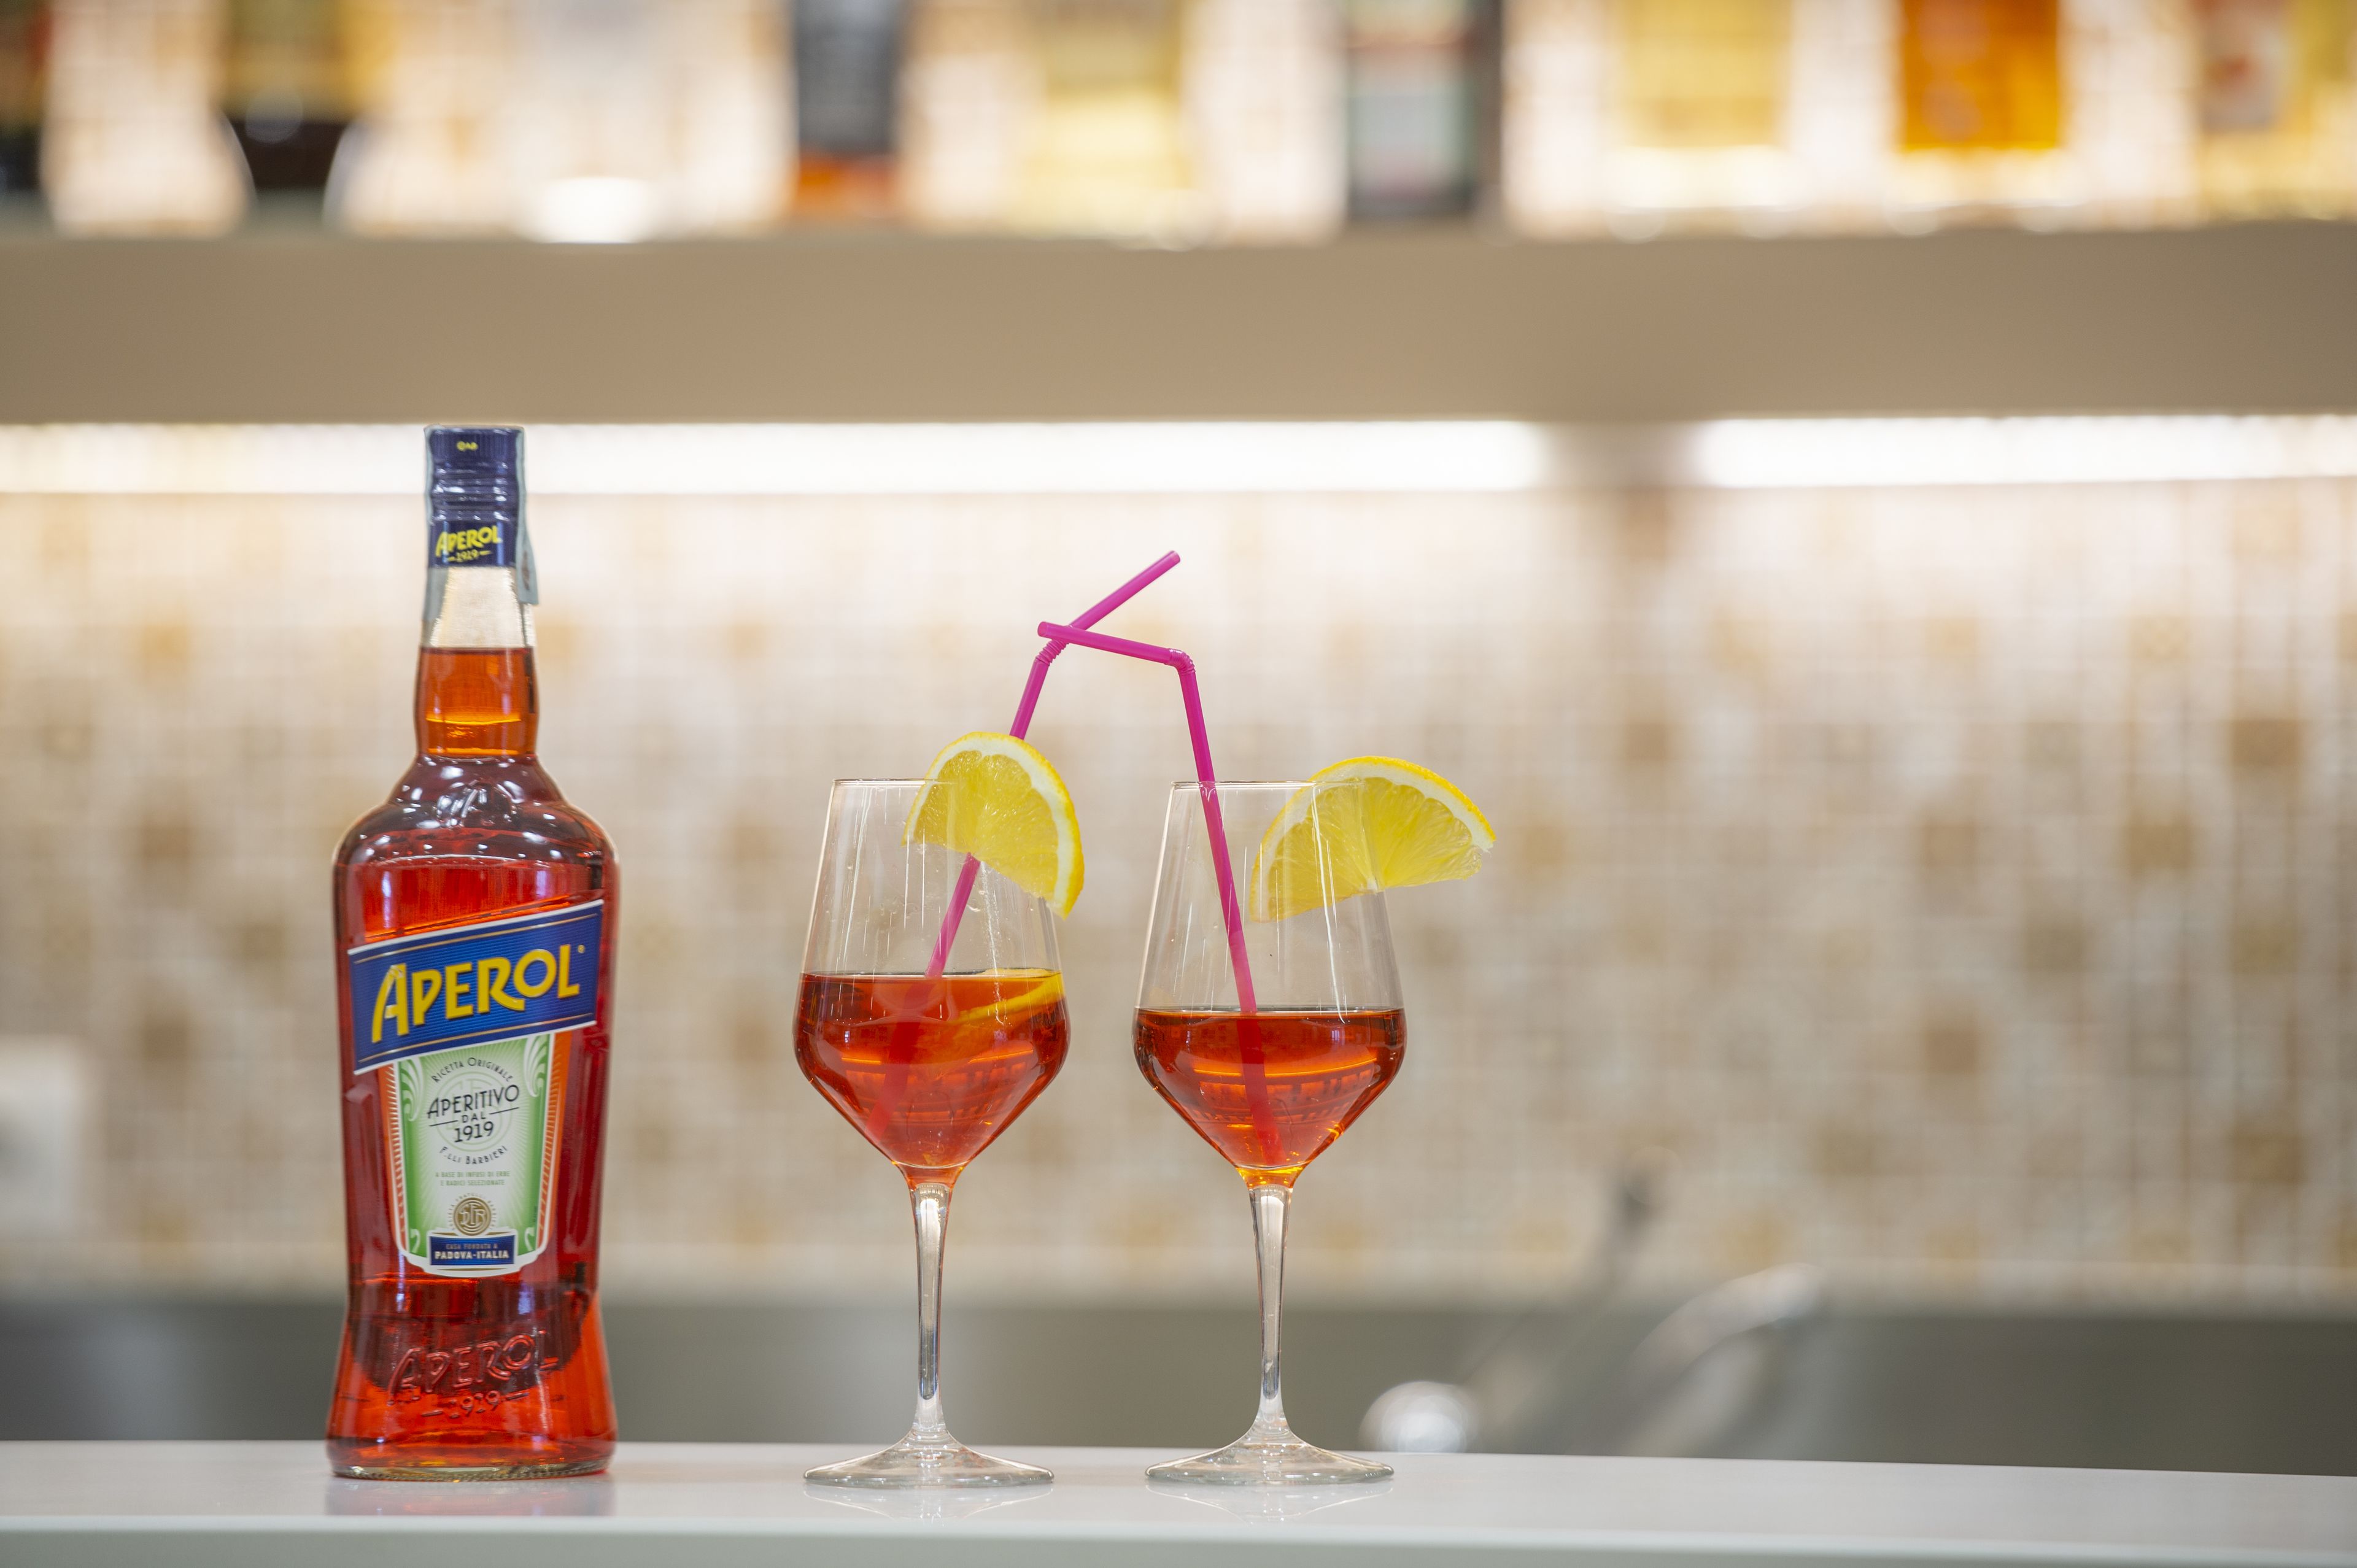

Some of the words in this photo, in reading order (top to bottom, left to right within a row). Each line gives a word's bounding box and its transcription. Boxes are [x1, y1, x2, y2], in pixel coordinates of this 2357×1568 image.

[435, 525, 502, 557] APEROL
[372, 944, 580, 1043] APEROL
[432, 1060, 464, 1083] RICETTA
[467, 1057, 513, 1081] ORIGINALE
[427, 1084, 519, 1119] APERITIVO
[462, 1111, 487, 1123] DAL
[454, 1121, 493, 1143] 1919
[465, 1145, 508, 1164] BARBIERI
[435, 1249, 509, 1259] PADOVA-ITALIA
